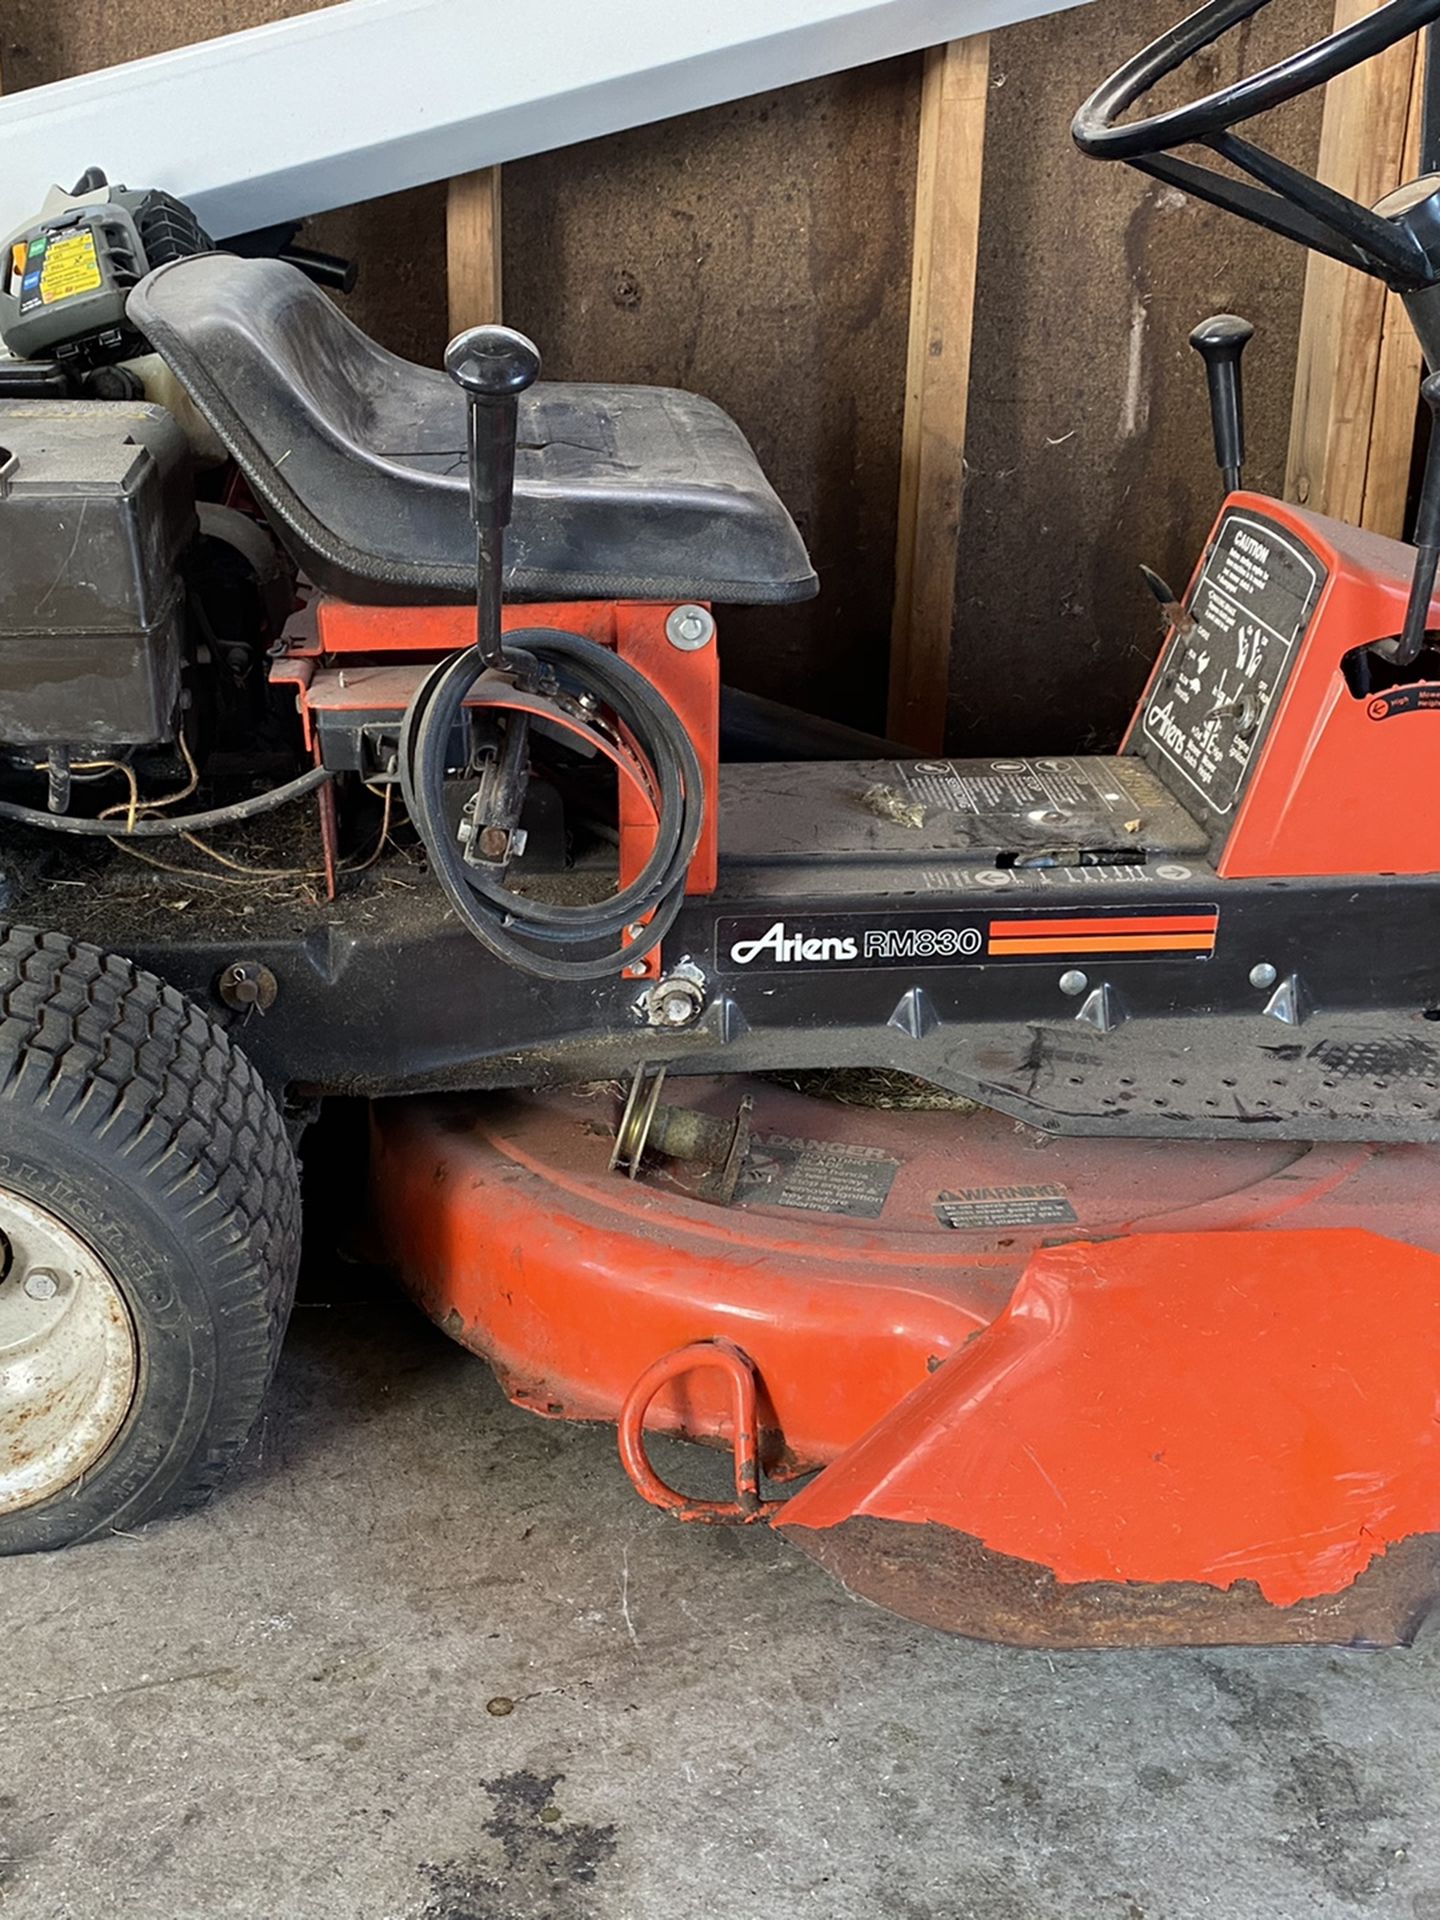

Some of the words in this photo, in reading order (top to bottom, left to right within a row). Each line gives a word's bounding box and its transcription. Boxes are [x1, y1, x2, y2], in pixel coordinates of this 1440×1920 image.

[1234, 530, 1270, 564] CAUTION
[1390, 696, 1409, 706] High
[1148, 701, 1186, 755] Ariens
[730, 922, 858, 964] Ariens
[864, 928, 983, 958] RM830
[768, 1134, 886, 1159] DANGER
[798, 1158, 844, 1170] BLADE
[800, 1152, 868, 1167] ROTATING
[794, 1164, 828, 1175] Keep
[784, 1184, 834, 1196] remove
[835, 1190, 884, 1203] ignition
[820, 1182, 865, 1194] engine
[959, 1184, 1057, 1201] WARNING
[781, 1191, 804, 1200] key
[807, 1194, 850, 1206] before
